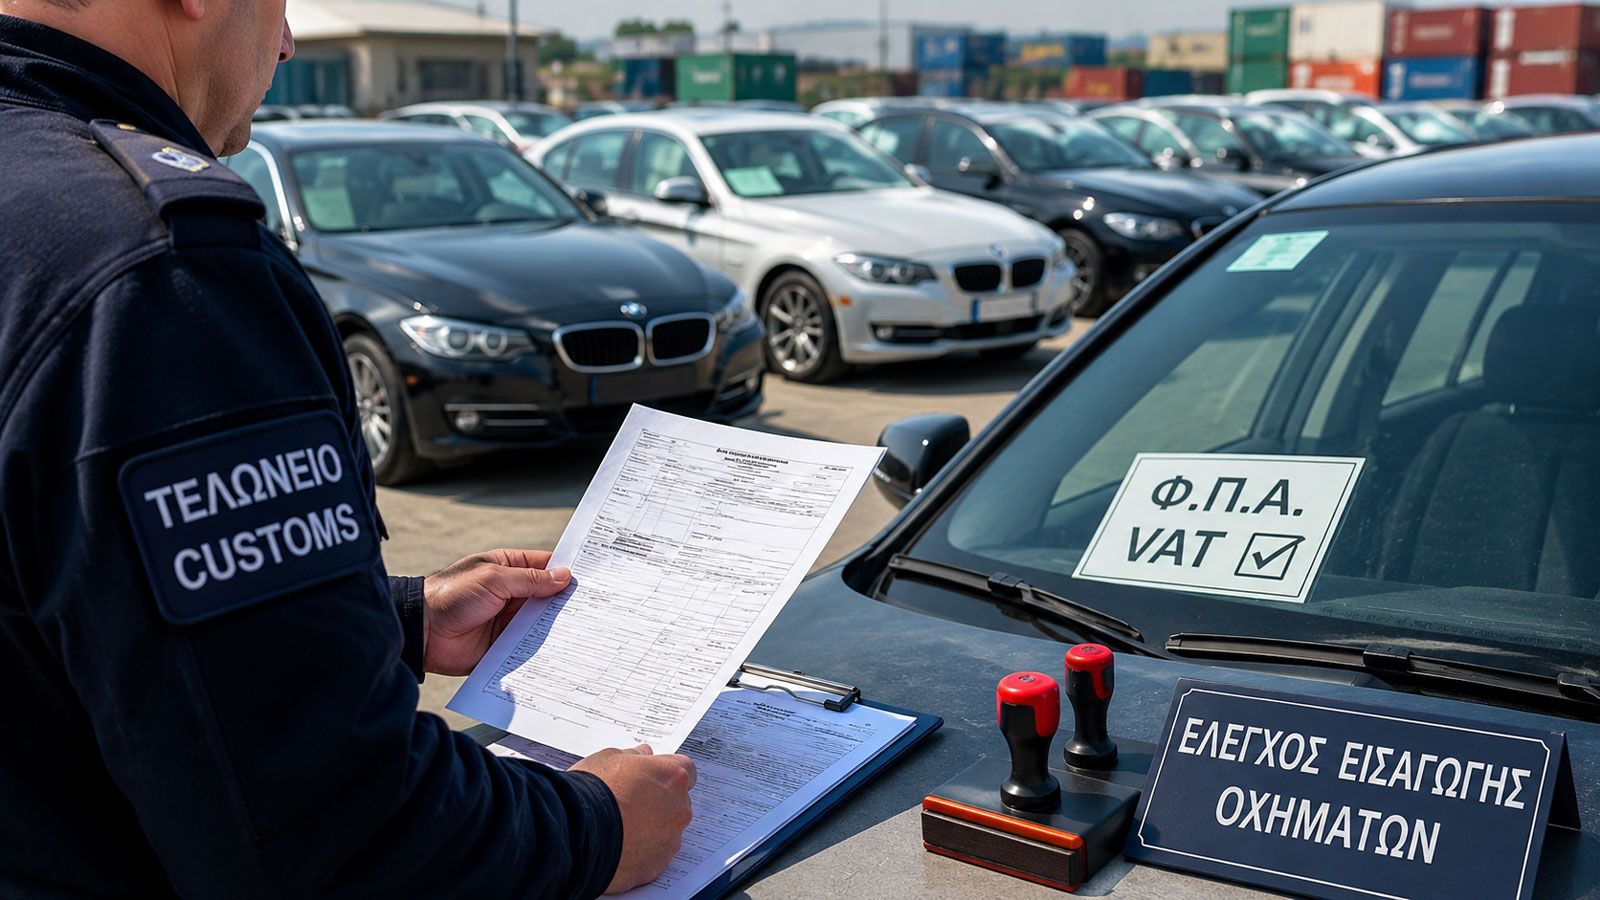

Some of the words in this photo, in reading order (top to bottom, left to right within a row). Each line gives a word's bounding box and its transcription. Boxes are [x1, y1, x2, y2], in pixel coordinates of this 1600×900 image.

[144, 444, 342, 529] ΤΕΛΩΝΕΙΟ
[1151, 475, 1303, 517] Φ.Π.Α.
[174, 503, 360, 590] CUSTOMS
[1127, 526, 1228, 568] VAT
[1177, 717, 1328, 775] ΕΛΕΓΧΟΣ
[1338, 741, 1532, 810] ΕΙΣΑΓΩΓΗΣ
[1215, 785, 1441, 865] ΟΧΗΜΑΤΩΝ
